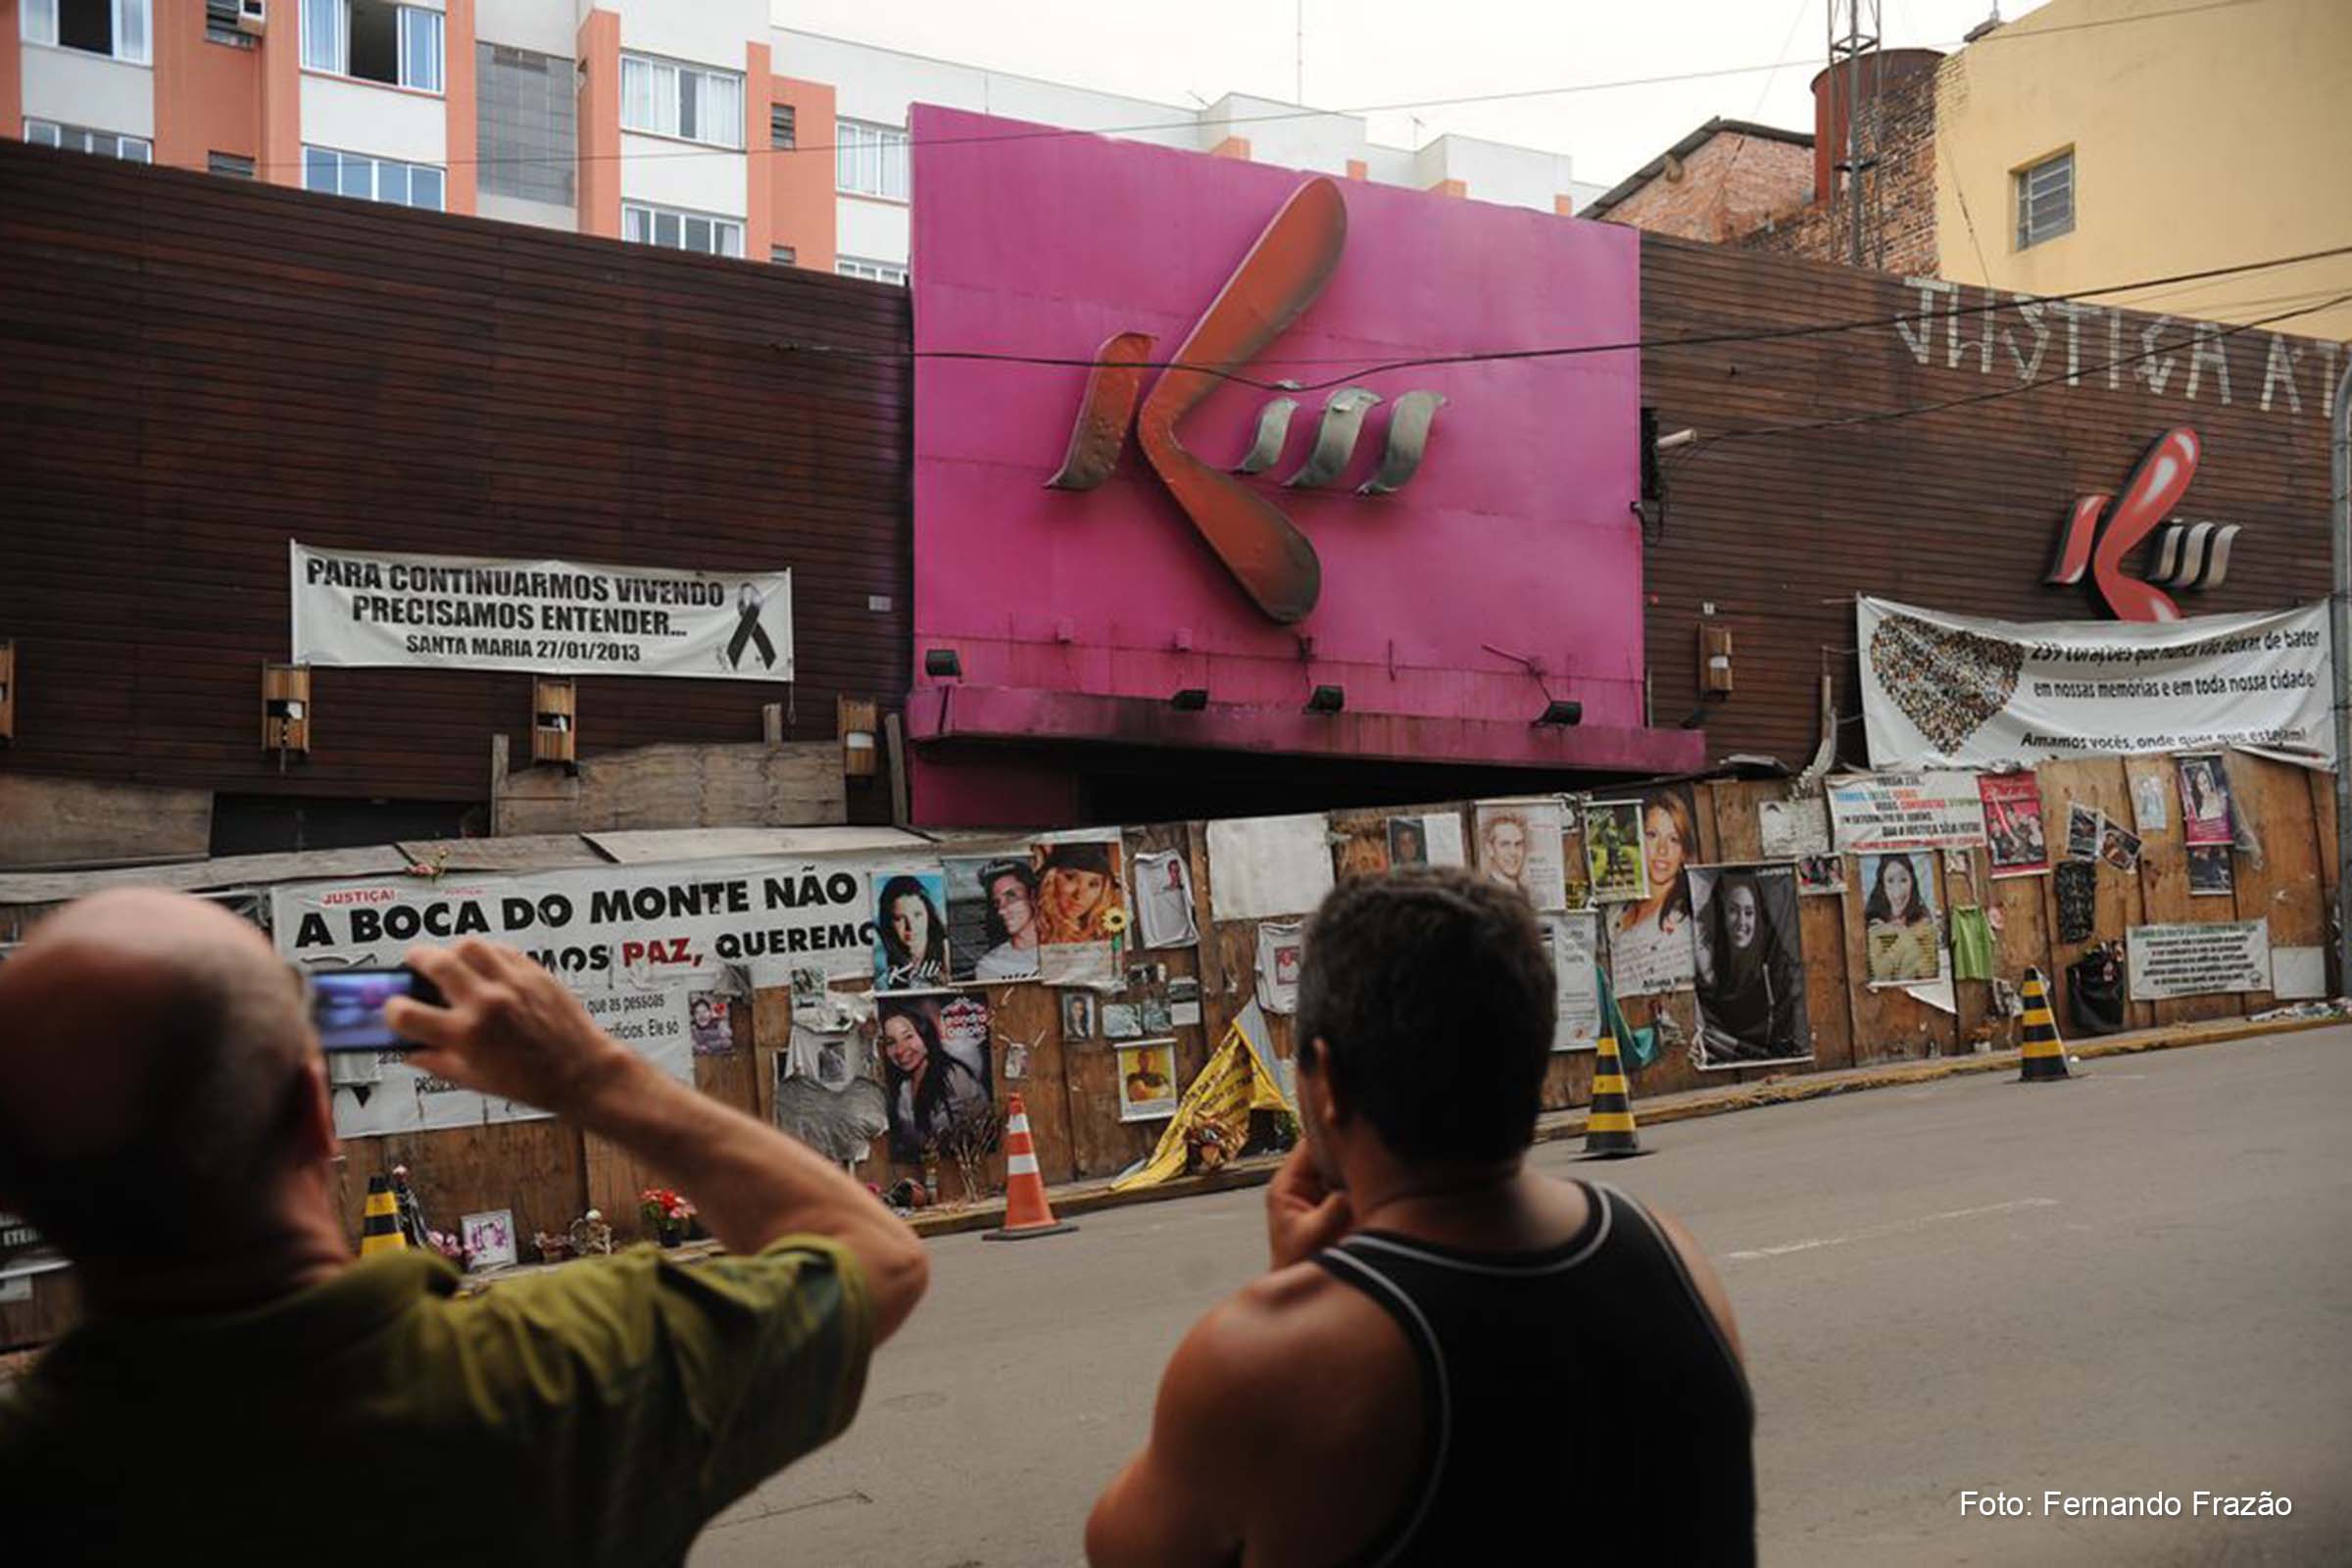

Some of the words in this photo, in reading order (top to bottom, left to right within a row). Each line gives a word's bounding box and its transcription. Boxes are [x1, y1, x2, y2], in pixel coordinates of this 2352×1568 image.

[307, 558, 382, 590] PARA
[389, 564, 610, 602] CONTINUARMOS
[614, 577, 724, 608] VIVENDO
[352, 595, 534, 630] PRECISAMOS
[541, 605, 688, 637] ENTENDER...
[406, 634, 467, 658] SANTA
[471, 638, 533, 659] MARIA
[537, 640, 640, 662] 27/01/2013
[2265, 630, 2281, 651] de
[2284, 629, 2320, 648] bater
[2034, 682, 2052, 698] em
[2054, 682, 2095, 698] nossas
[2097, 676, 2160, 698] memórias
[2163, 681, 2171, 697] e
[2173, 680, 2193, 696] em
[2195, 674, 2228, 695] toda
[2229, 674, 2268, 692] nossa
[2021, 732, 2087, 750] Amamos
[2136, 731, 2175, 747] onde
[296, 912, 335, 949] A
[350, 900, 491, 945] BOCA
[502, 893, 573, 932] DO
[590, 879, 750, 924] MONTE
[763, 865, 858, 910] NÃO
[322, 888, 395, 906] JUSTIÇA!
[621, 937, 704, 968] PAZ,
[714, 921, 875, 960] QUEREMO
[623, 993, 665, 1015] pessoas
[649, 1018, 664, 1037] Ele
